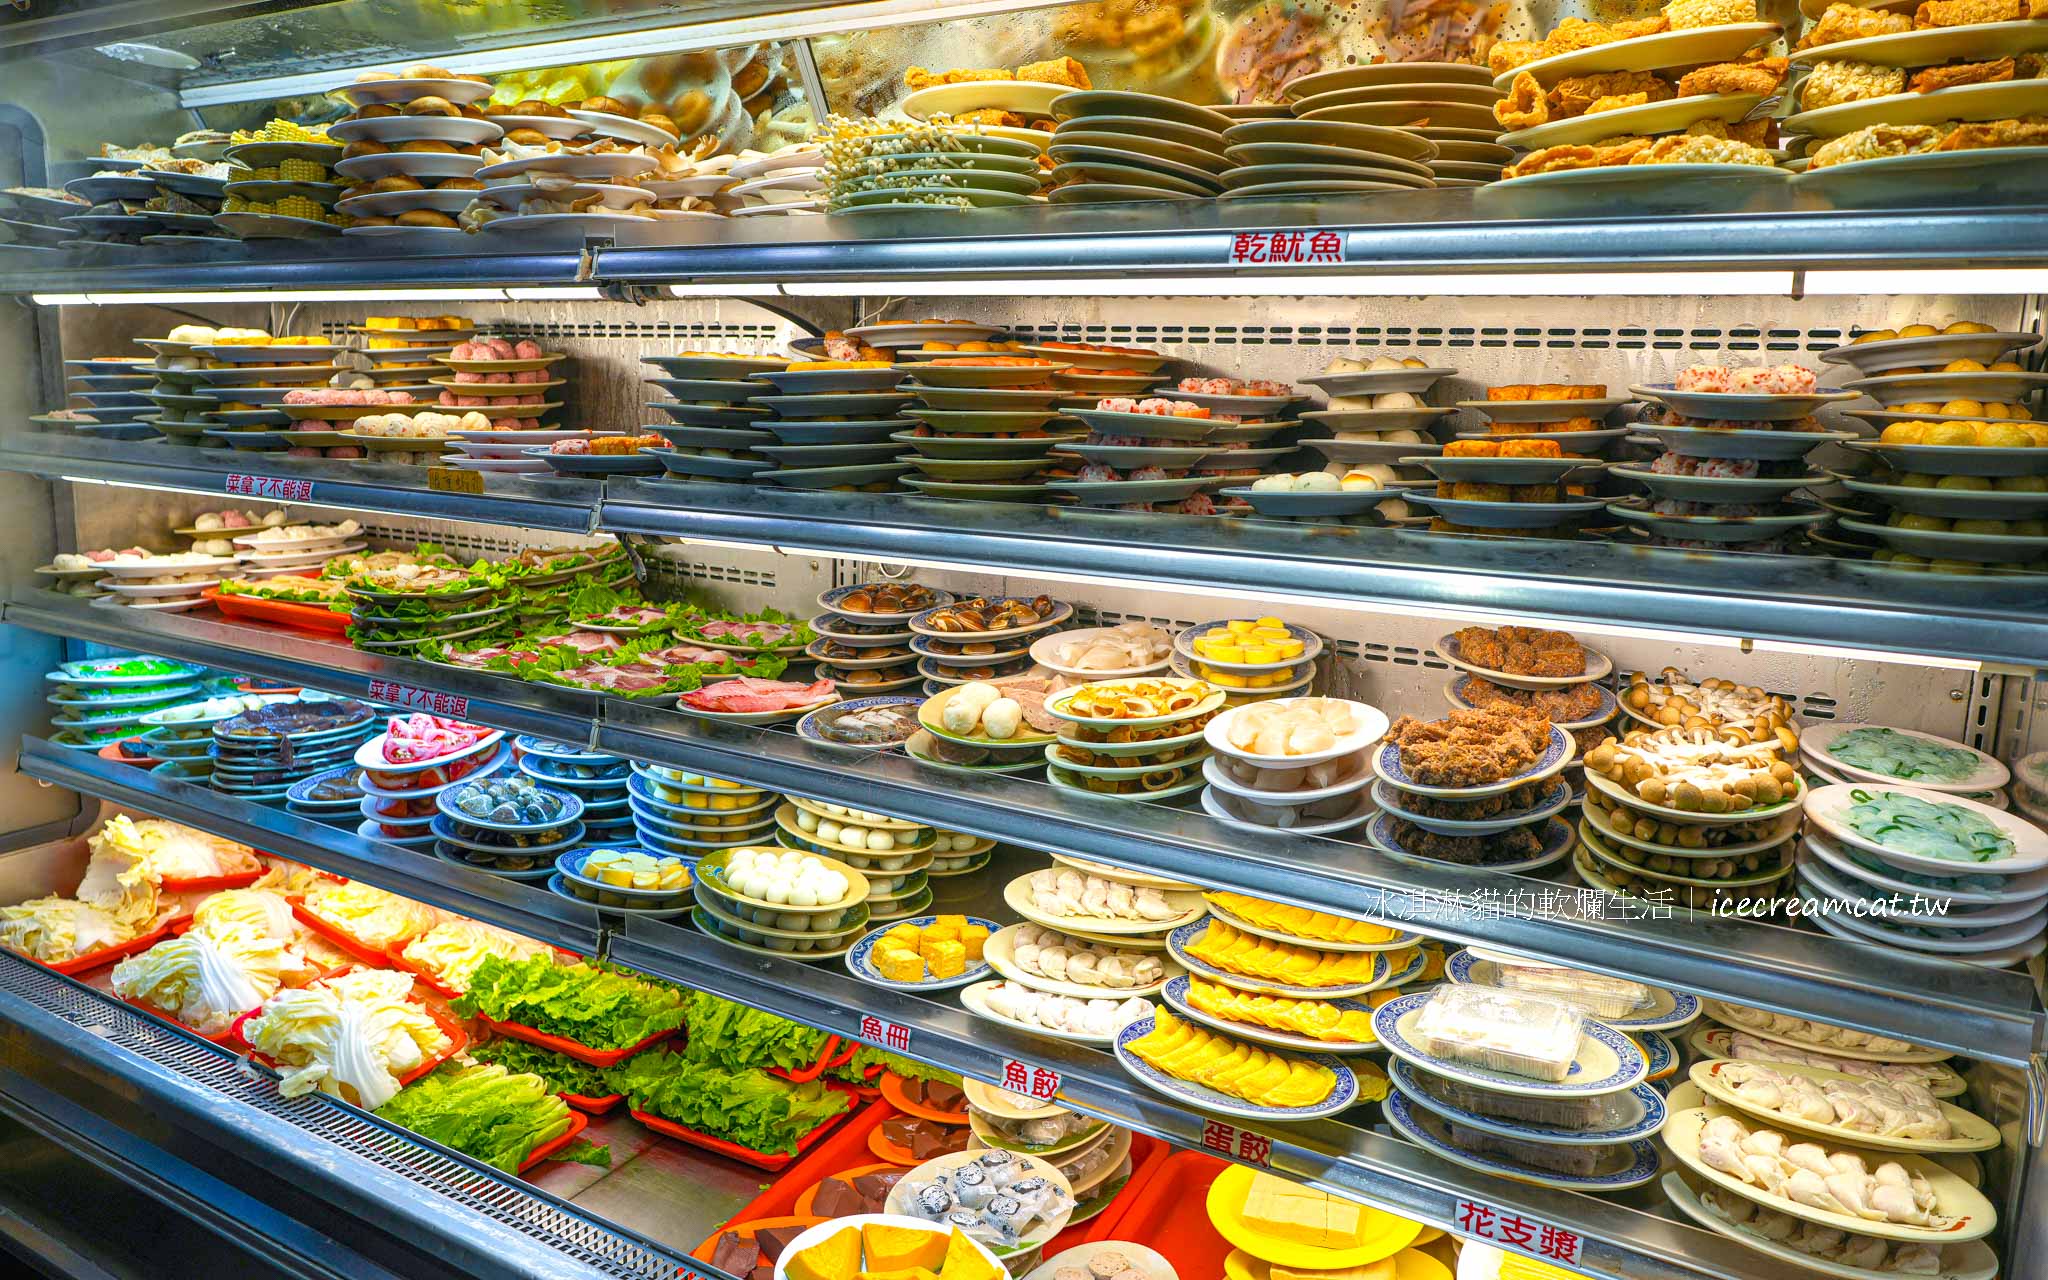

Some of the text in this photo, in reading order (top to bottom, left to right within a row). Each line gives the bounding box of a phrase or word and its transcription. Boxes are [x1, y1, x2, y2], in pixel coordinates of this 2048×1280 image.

[1232, 231, 1342, 262] 乾魷魚
[227, 474, 311, 501] 菜拿了不能退
[370, 680, 467, 717] 菜拿了不能退
[1003, 1060, 1059, 1099] 魚餃
[1204, 1120, 1270, 1167] 蛋餃
[1459, 1202, 1578, 1264] 花支漿
